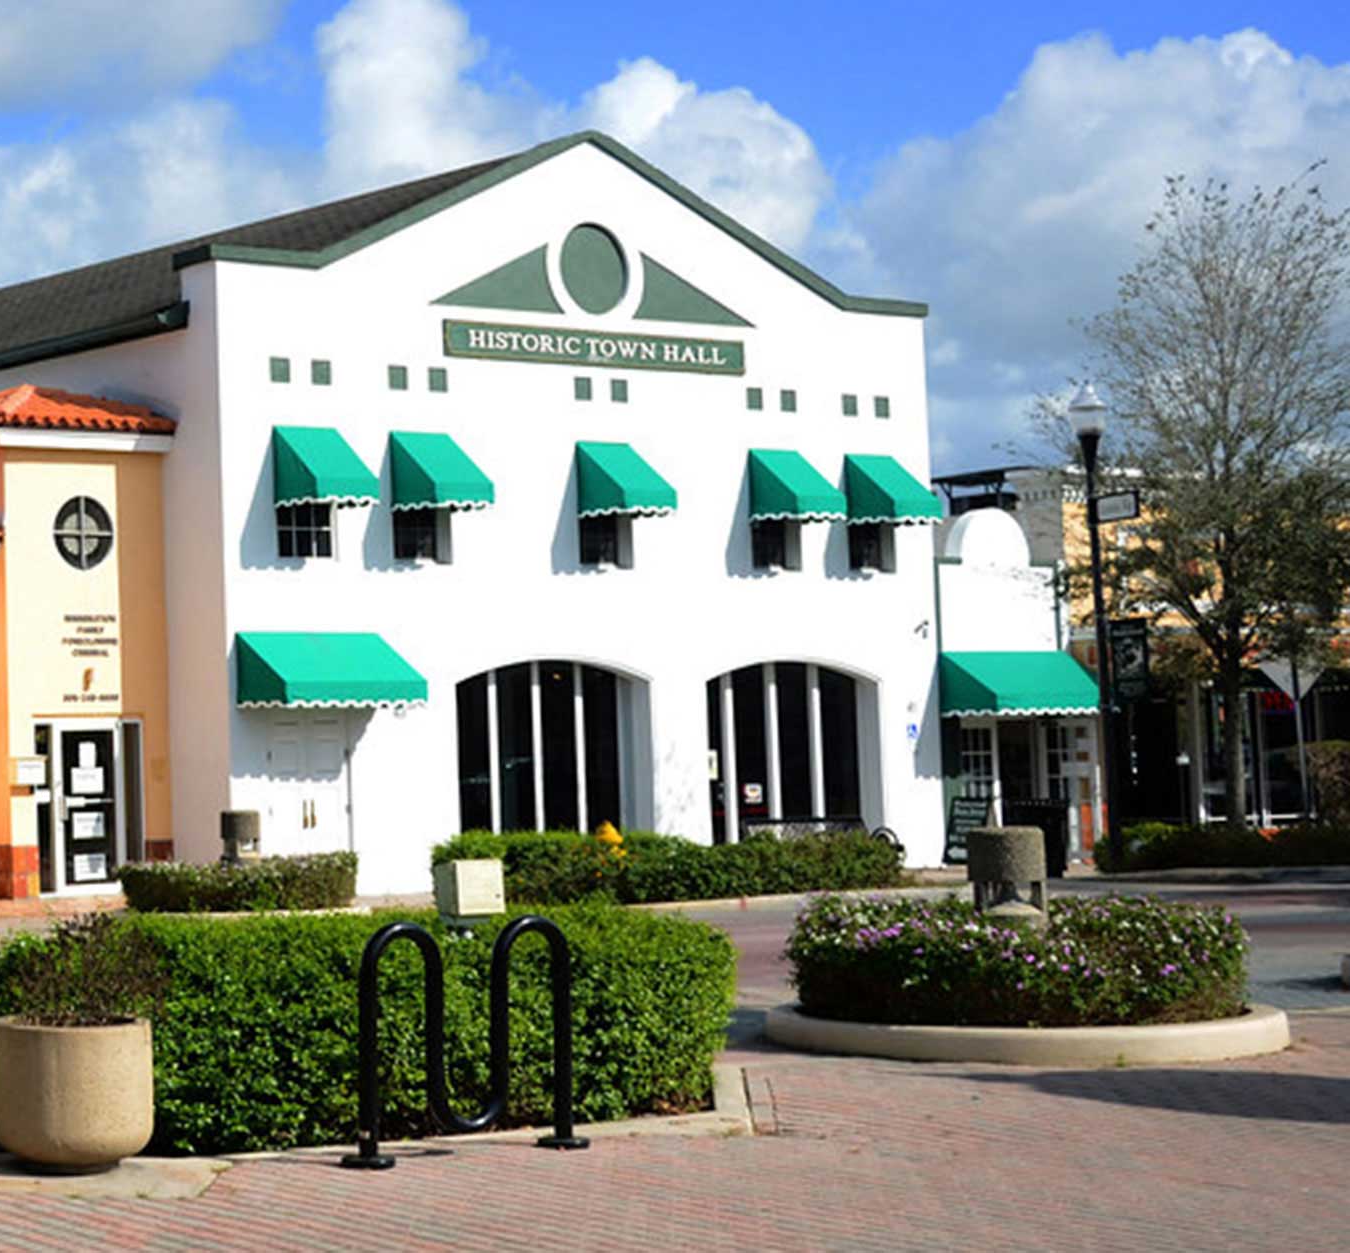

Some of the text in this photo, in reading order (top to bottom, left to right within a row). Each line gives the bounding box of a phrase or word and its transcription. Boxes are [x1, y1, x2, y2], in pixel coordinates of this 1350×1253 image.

[468, 328, 727, 366] HISTORIC TOWN HALL
